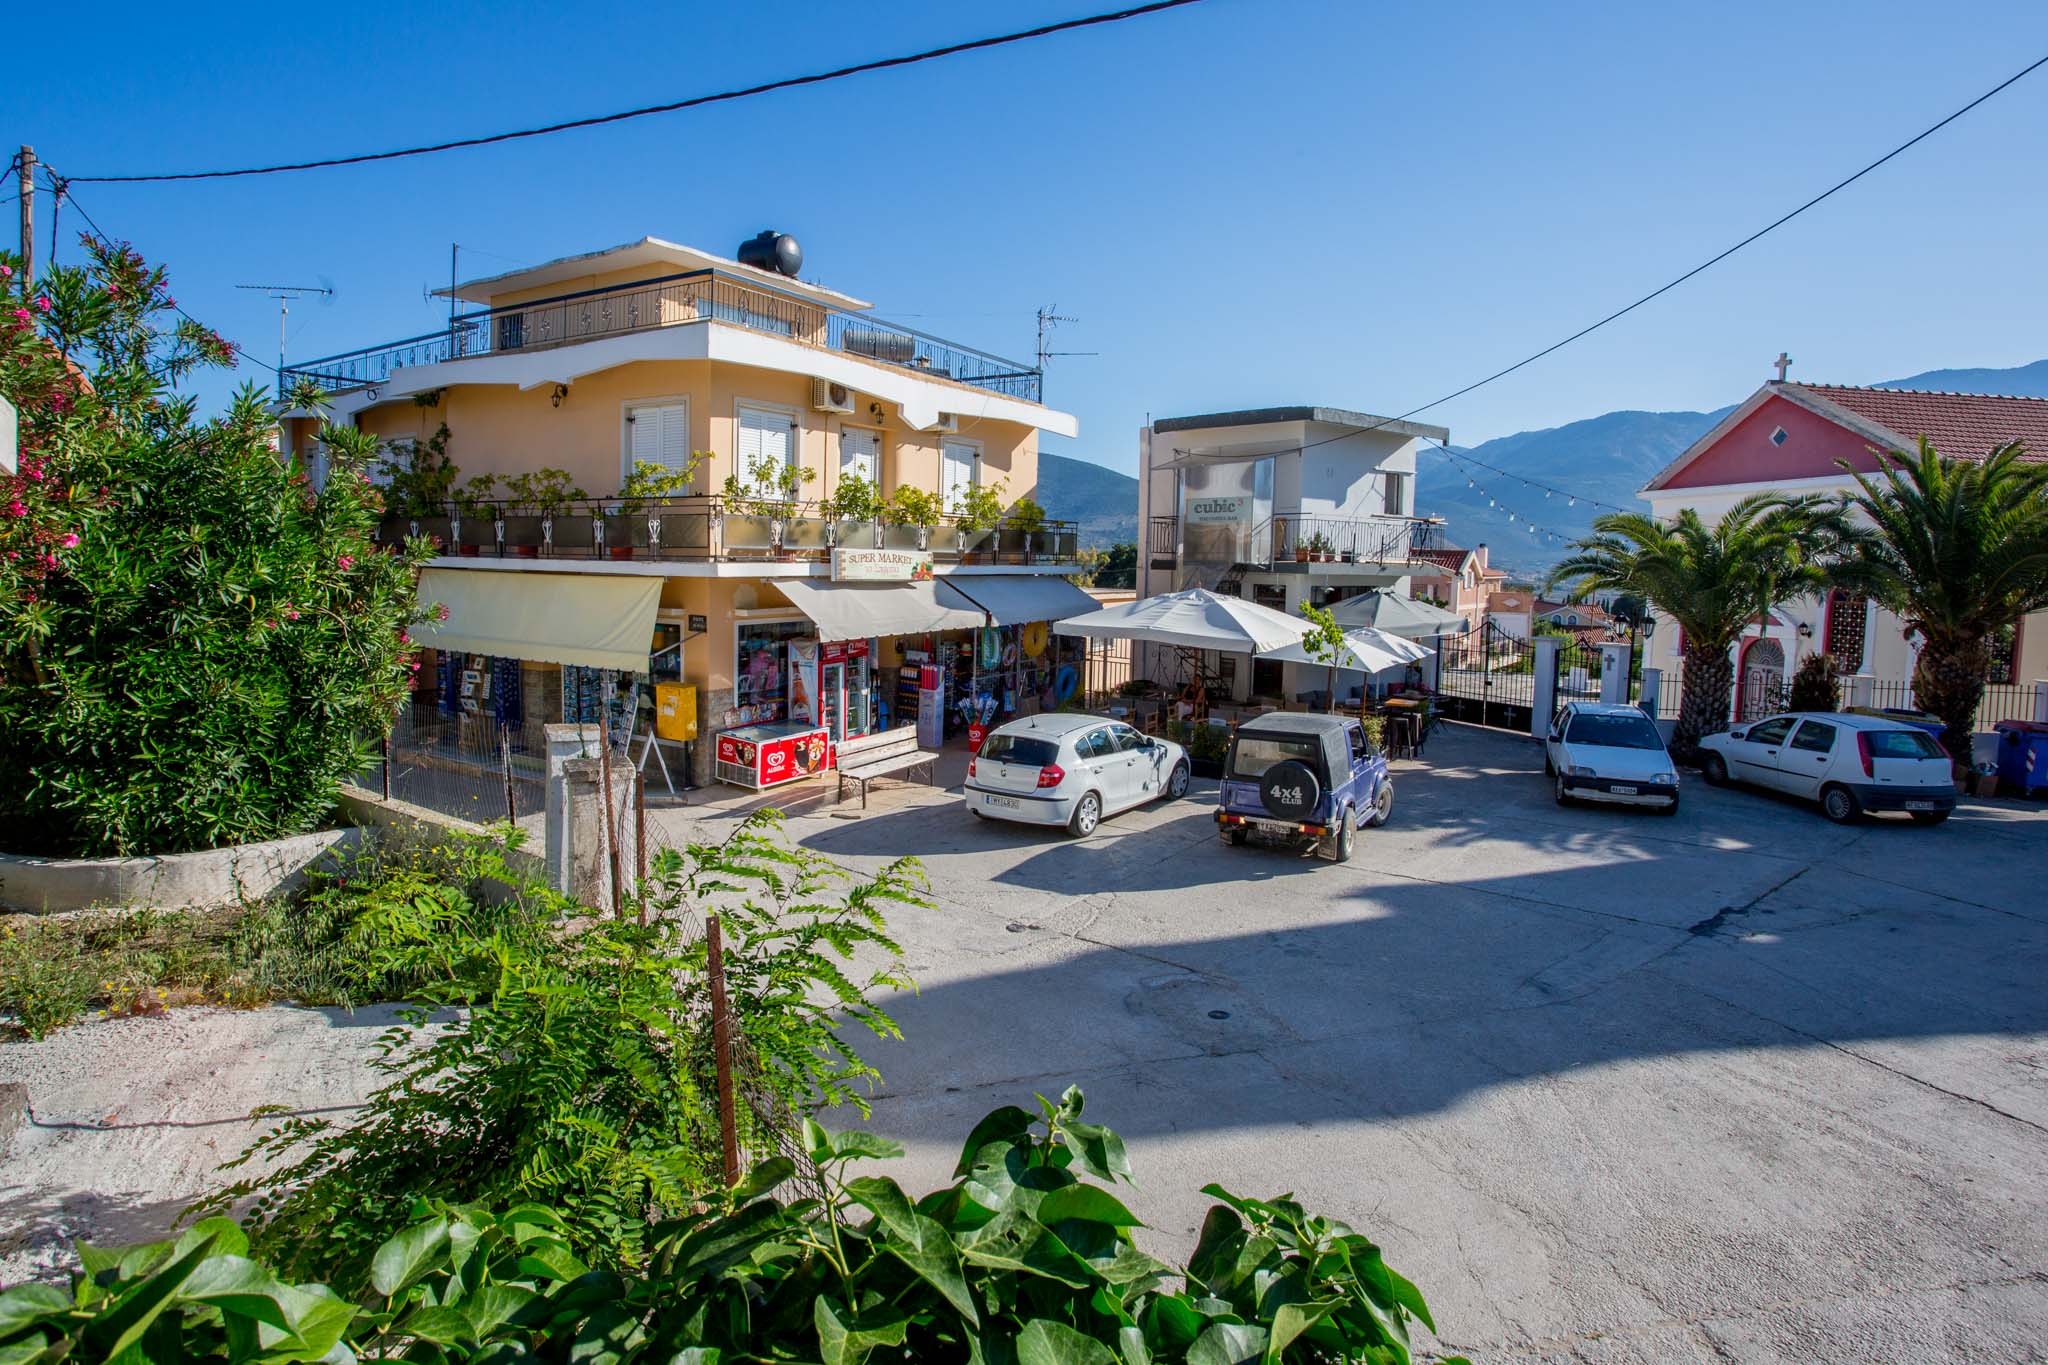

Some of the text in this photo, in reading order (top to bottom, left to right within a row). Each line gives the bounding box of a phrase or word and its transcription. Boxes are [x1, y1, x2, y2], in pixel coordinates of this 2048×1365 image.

[1194, 499, 1236, 514] cubic
[848, 553, 913, 565] SUPER MARKET
[1270, 785, 1303, 799] 4x4
